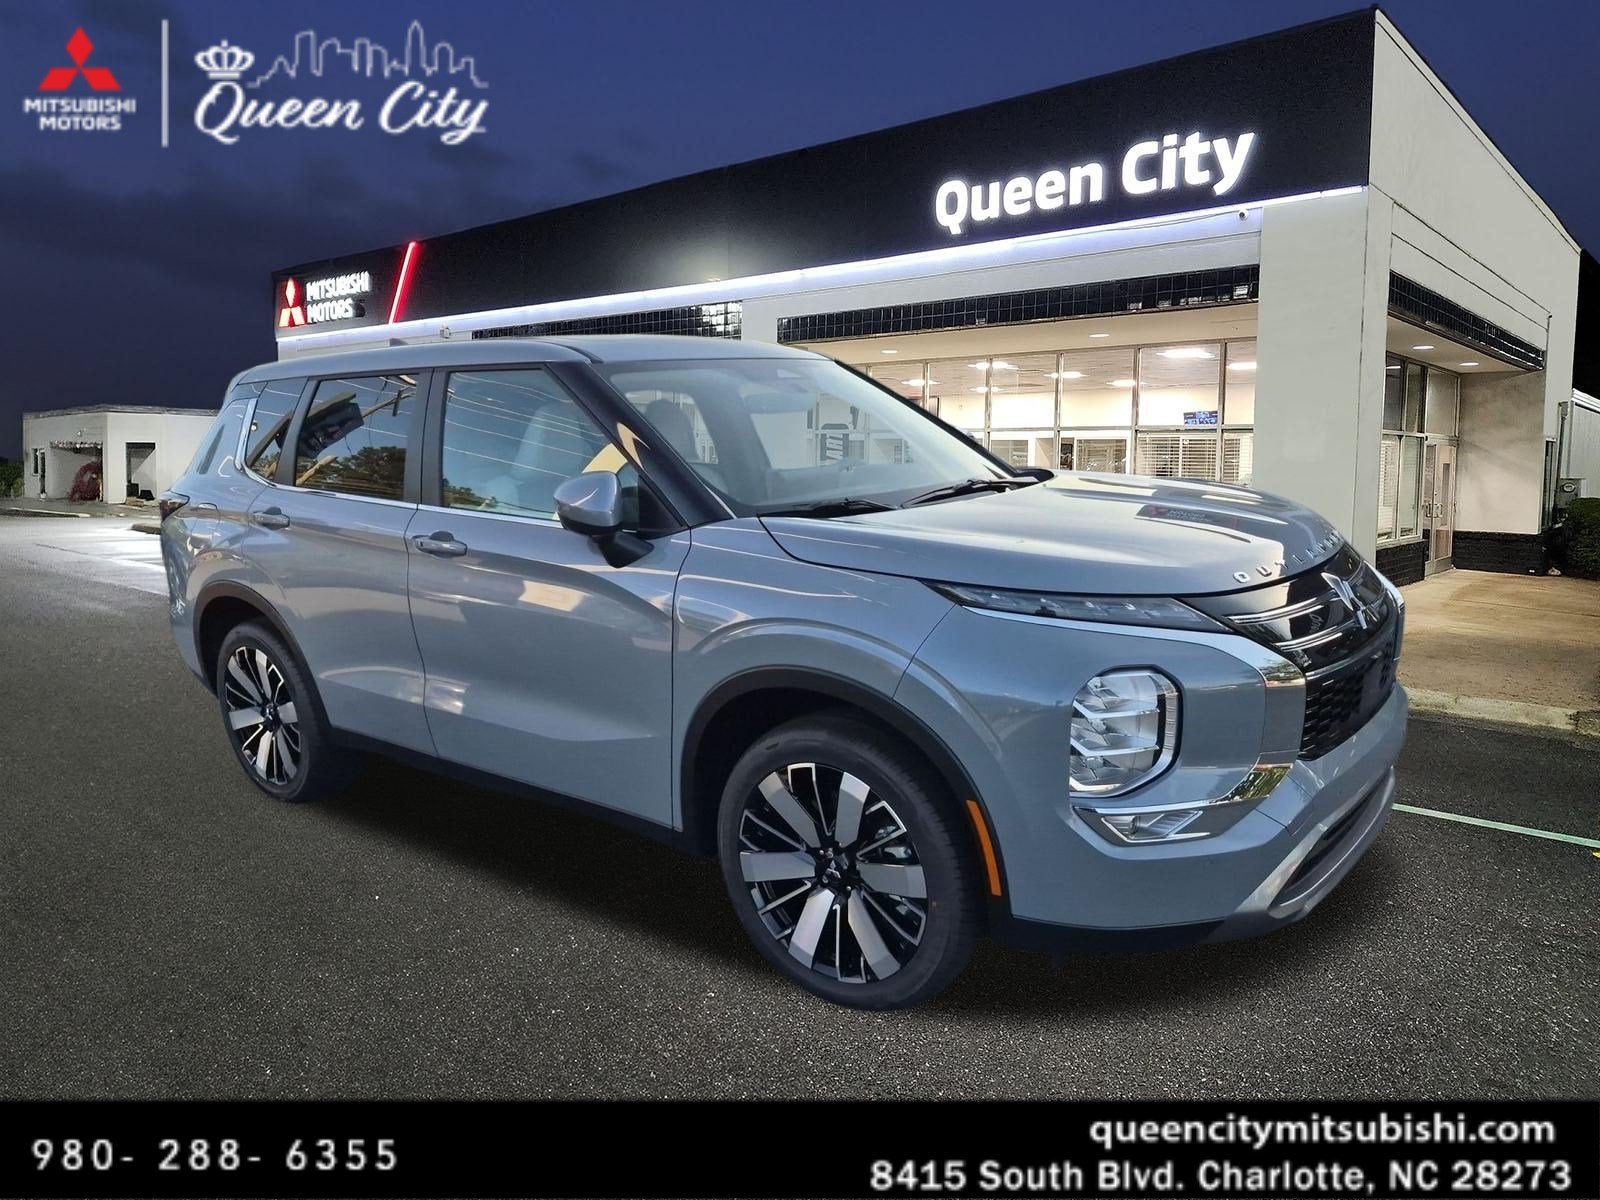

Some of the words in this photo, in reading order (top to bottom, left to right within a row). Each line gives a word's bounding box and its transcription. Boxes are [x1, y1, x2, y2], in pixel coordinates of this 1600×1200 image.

[935, 161, 1104, 235] Queen
[1121, 131, 1256, 196] City
[305, 270, 371, 302] MITSUBISHI
[306, 297, 356, 323] MOTORS
[1232, 530, 1342, 584] OUTLAN
